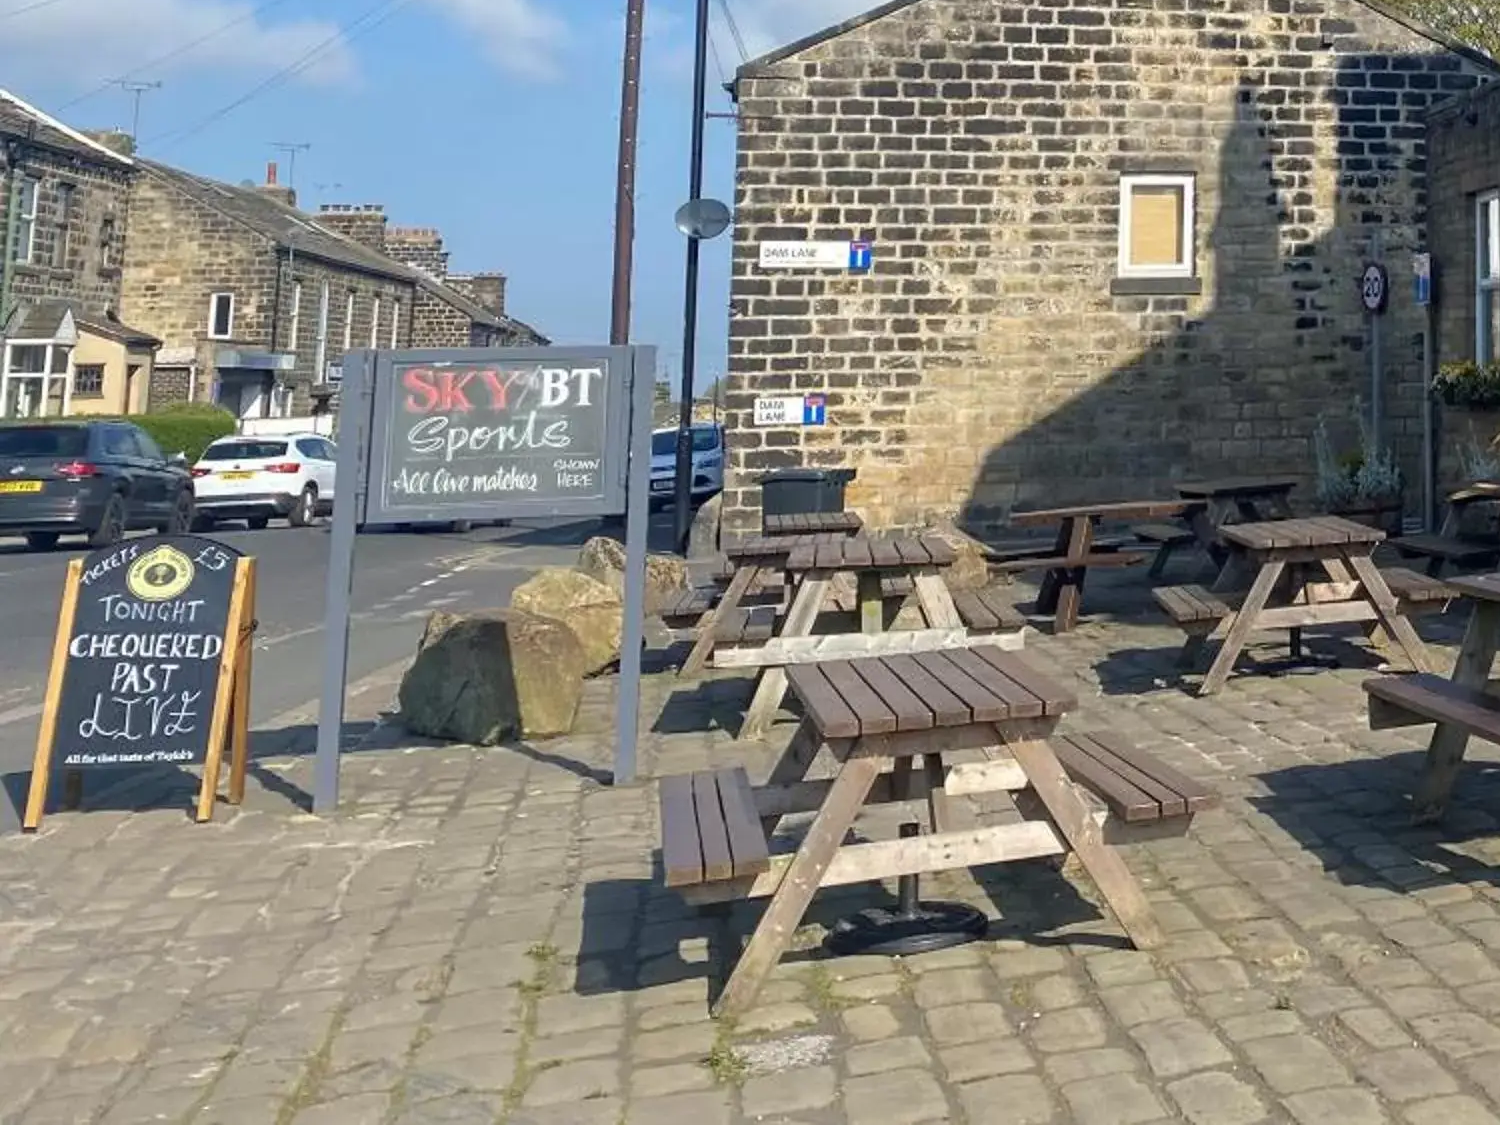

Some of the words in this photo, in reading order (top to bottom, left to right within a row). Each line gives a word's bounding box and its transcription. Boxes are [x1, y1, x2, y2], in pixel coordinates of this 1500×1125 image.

[1365, 276, 1381, 298] 20
[408, 411, 571, 462] Sports
[553, 459, 601, 470] SHOWN
[393, 467, 430, 494] All
[432, 467, 469, 494] live
[472, 465, 538, 492] matches
[557, 472, 593, 488] HERE
[80, 544, 141, 586] TICKETS
[193, 546, 231, 572] £5
[98, 594, 206, 623] TONIGHT
[69, 633, 223, 660] CHEQUERED
[111, 662, 180, 695] PAST
[79, 690, 202, 741] LIVE
